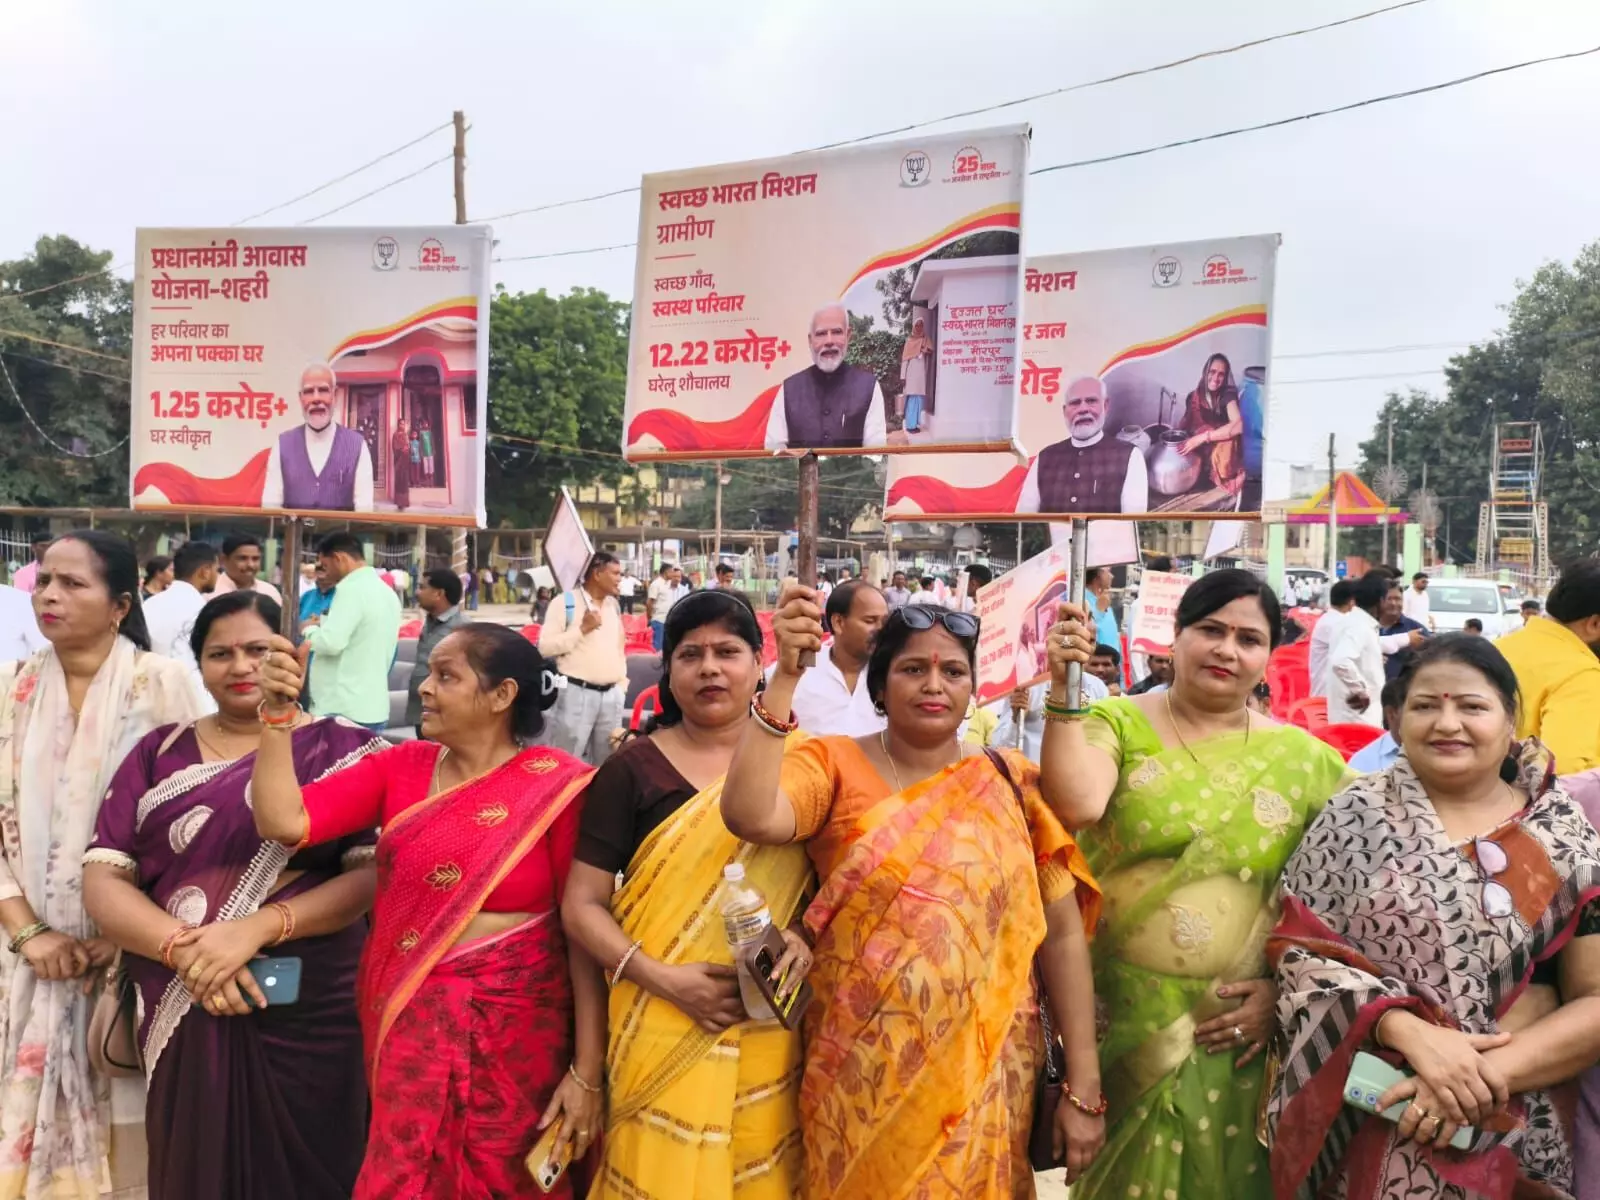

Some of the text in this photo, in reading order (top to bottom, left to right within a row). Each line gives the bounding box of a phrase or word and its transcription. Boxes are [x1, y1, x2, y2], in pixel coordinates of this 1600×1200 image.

[957, 156, 979, 173] 25
[658, 171, 817, 212] स्वच्छ भारत मिशन
[656, 215, 715, 245] ग्रामीण
[151, 239, 307, 270] प्रधानमंत्री आवास
[422, 247, 441, 263] 25
[1207, 262, 1227, 278] 25
[151, 270, 269, 302] योजना-शहरी
[654, 275, 686, 293] स्वच्छ
[652, 293, 745, 318] स्वस्थ परिवार
[151, 319, 229, 340] हर परिवार का
[1035, 323, 1067, 340] जल
[151, 344, 264, 362] अपना पक्का घर
[649, 328, 791, 371] 12.22 करोड़+
[648, 371, 730, 398] घरेलू शौचालय
[150, 382, 289, 429] 1.25 करोड़+
[150, 425, 212, 451] घर स्वीकृत
